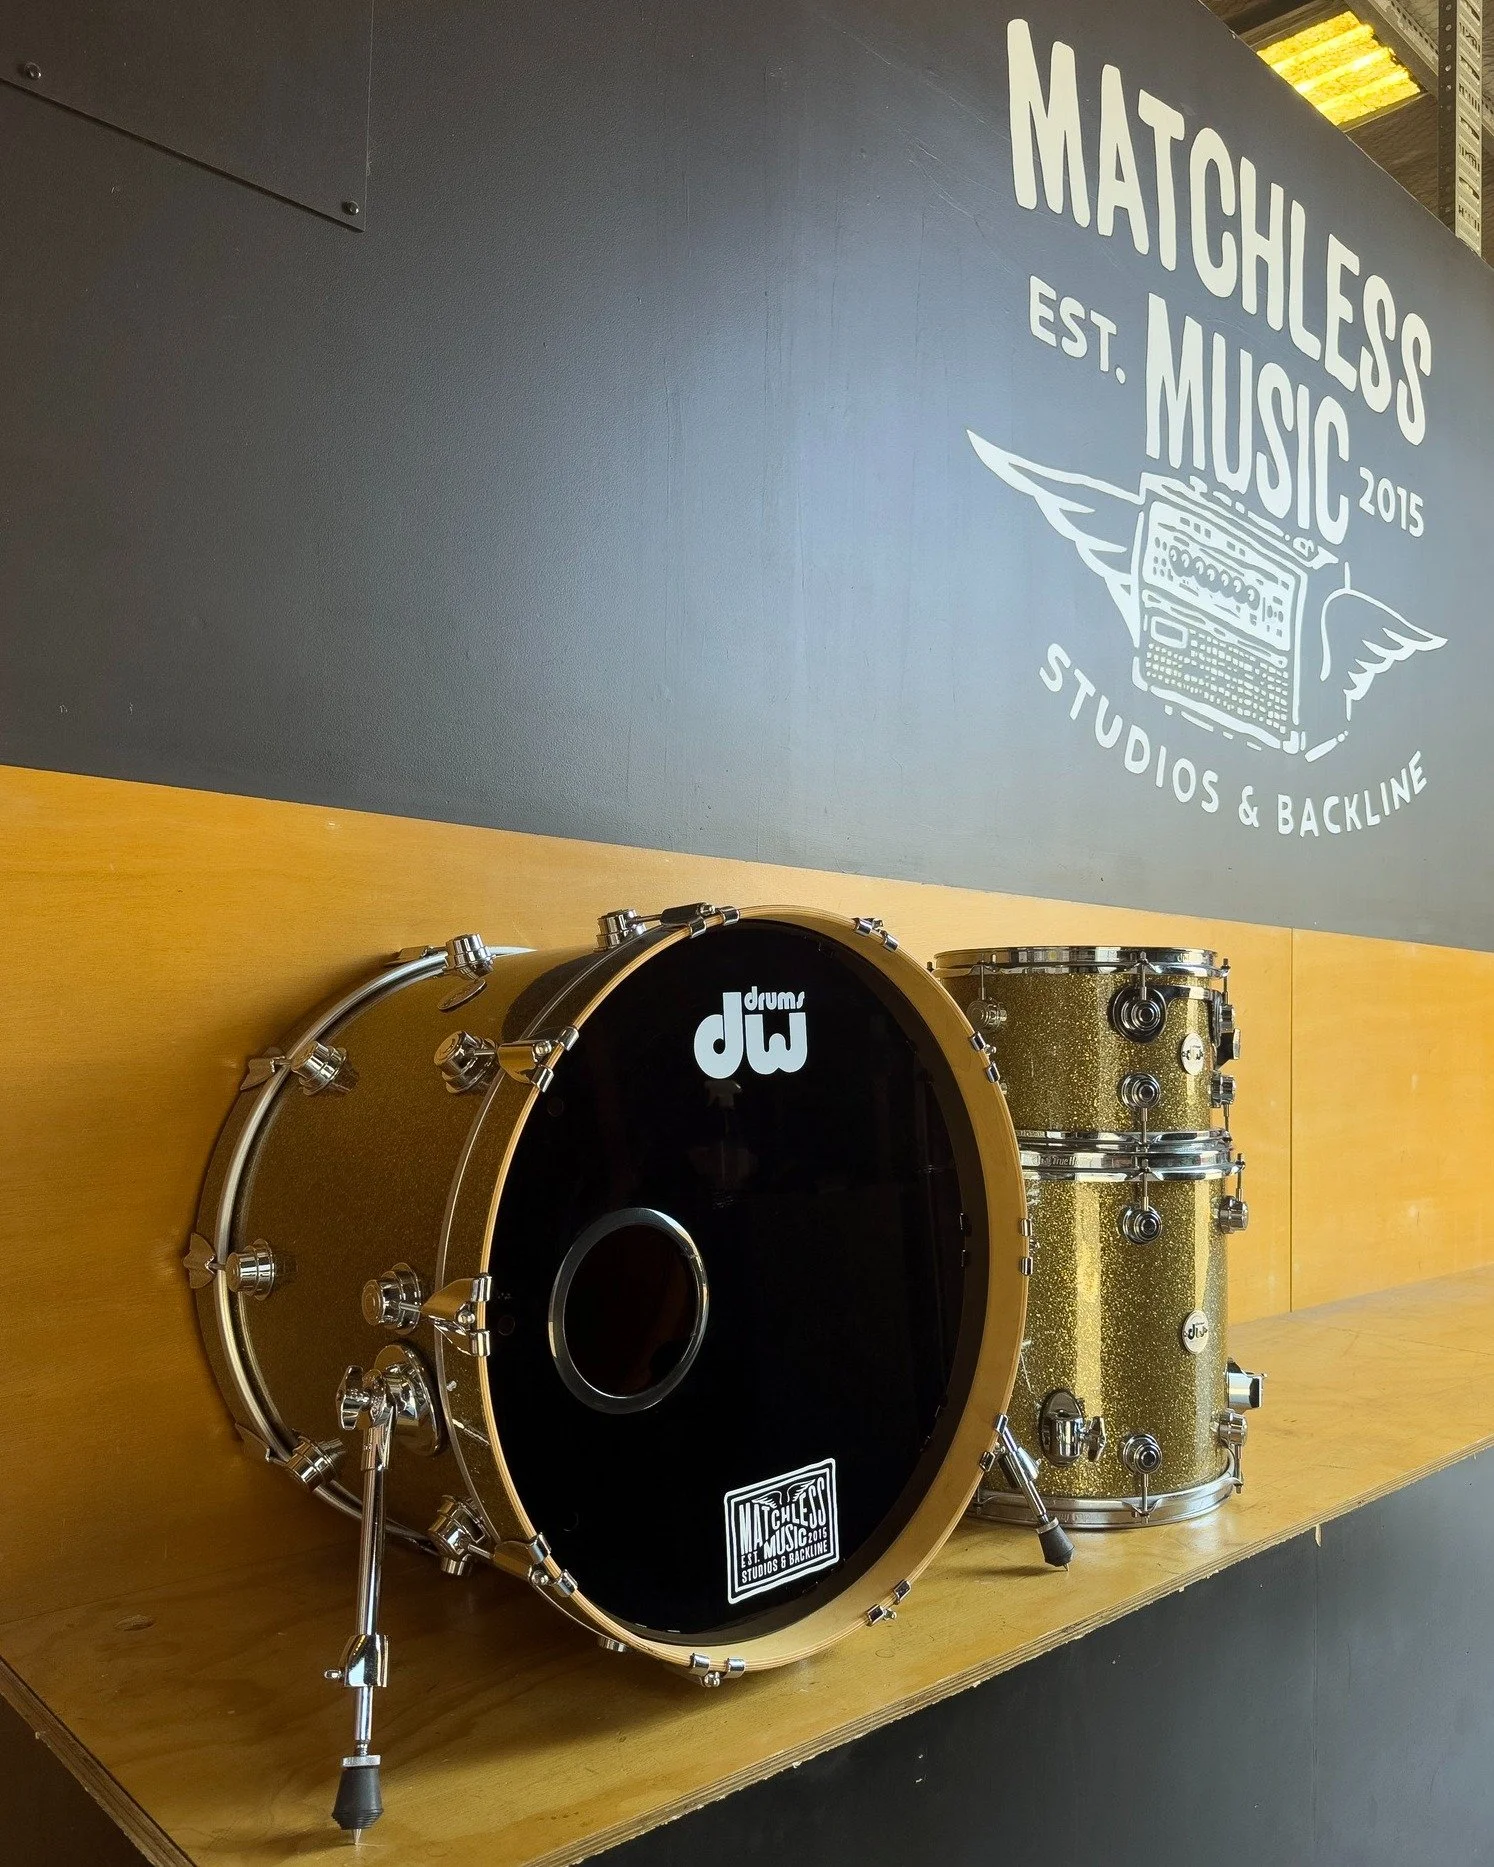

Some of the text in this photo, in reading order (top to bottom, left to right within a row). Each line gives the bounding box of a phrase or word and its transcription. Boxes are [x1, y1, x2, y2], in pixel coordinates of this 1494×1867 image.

[1006, 18, 1432, 446] MATCHLESS
[1029, 275, 1127, 384] EST.
[1145, 293, 1350, 545] MUSIC
[1358, 466, 1425, 538] 2015
[1039, 643, 1429, 838] STUDIOS & BACKLINE
[693, 991, 808, 1080] dw
[743, 985, 806, 1011] drums
[738, 1476, 827, 1555] MATCHLESS
[763, 1523, 807, 1560] MUSIC
[807, 1527, 828, 1544] 2015
[741, 1552, 761, 1569] EST.
[741, 1540, 828, 1584] STUDIOS & BACKLINE
